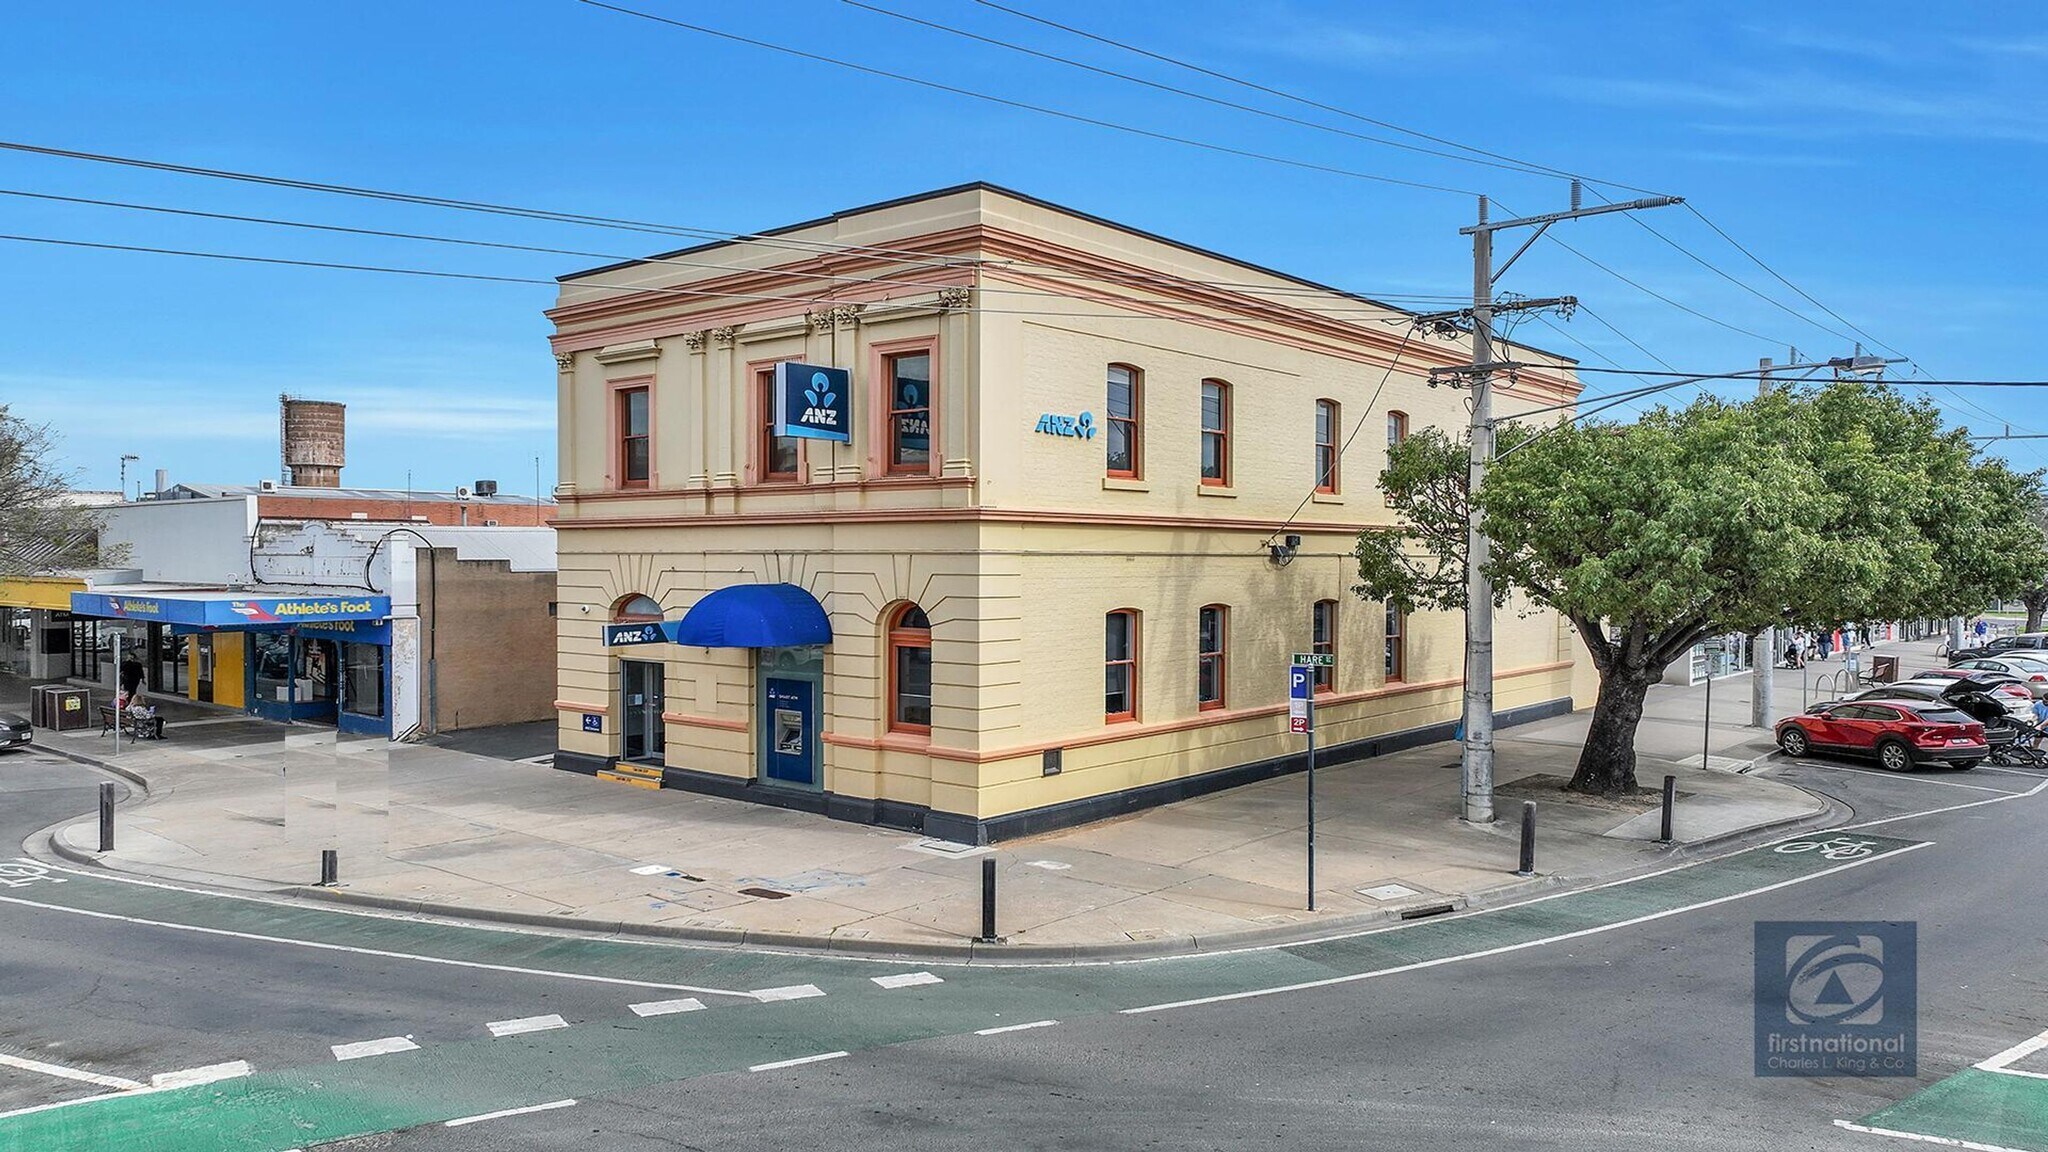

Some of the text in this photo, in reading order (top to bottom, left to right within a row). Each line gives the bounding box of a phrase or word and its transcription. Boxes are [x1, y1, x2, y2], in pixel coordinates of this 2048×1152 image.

[801, 407, 837, 425] ANZ
[1035, 413, 1075, 437] ANZ
[274, 602, 338, 615] Athlete's
[341, 601, 372, 613] Foot
[613, 630, 642, 644] ANZ
[1300, 655, 1324, 665] HARE
[1293, 673, 1305, 688] P
